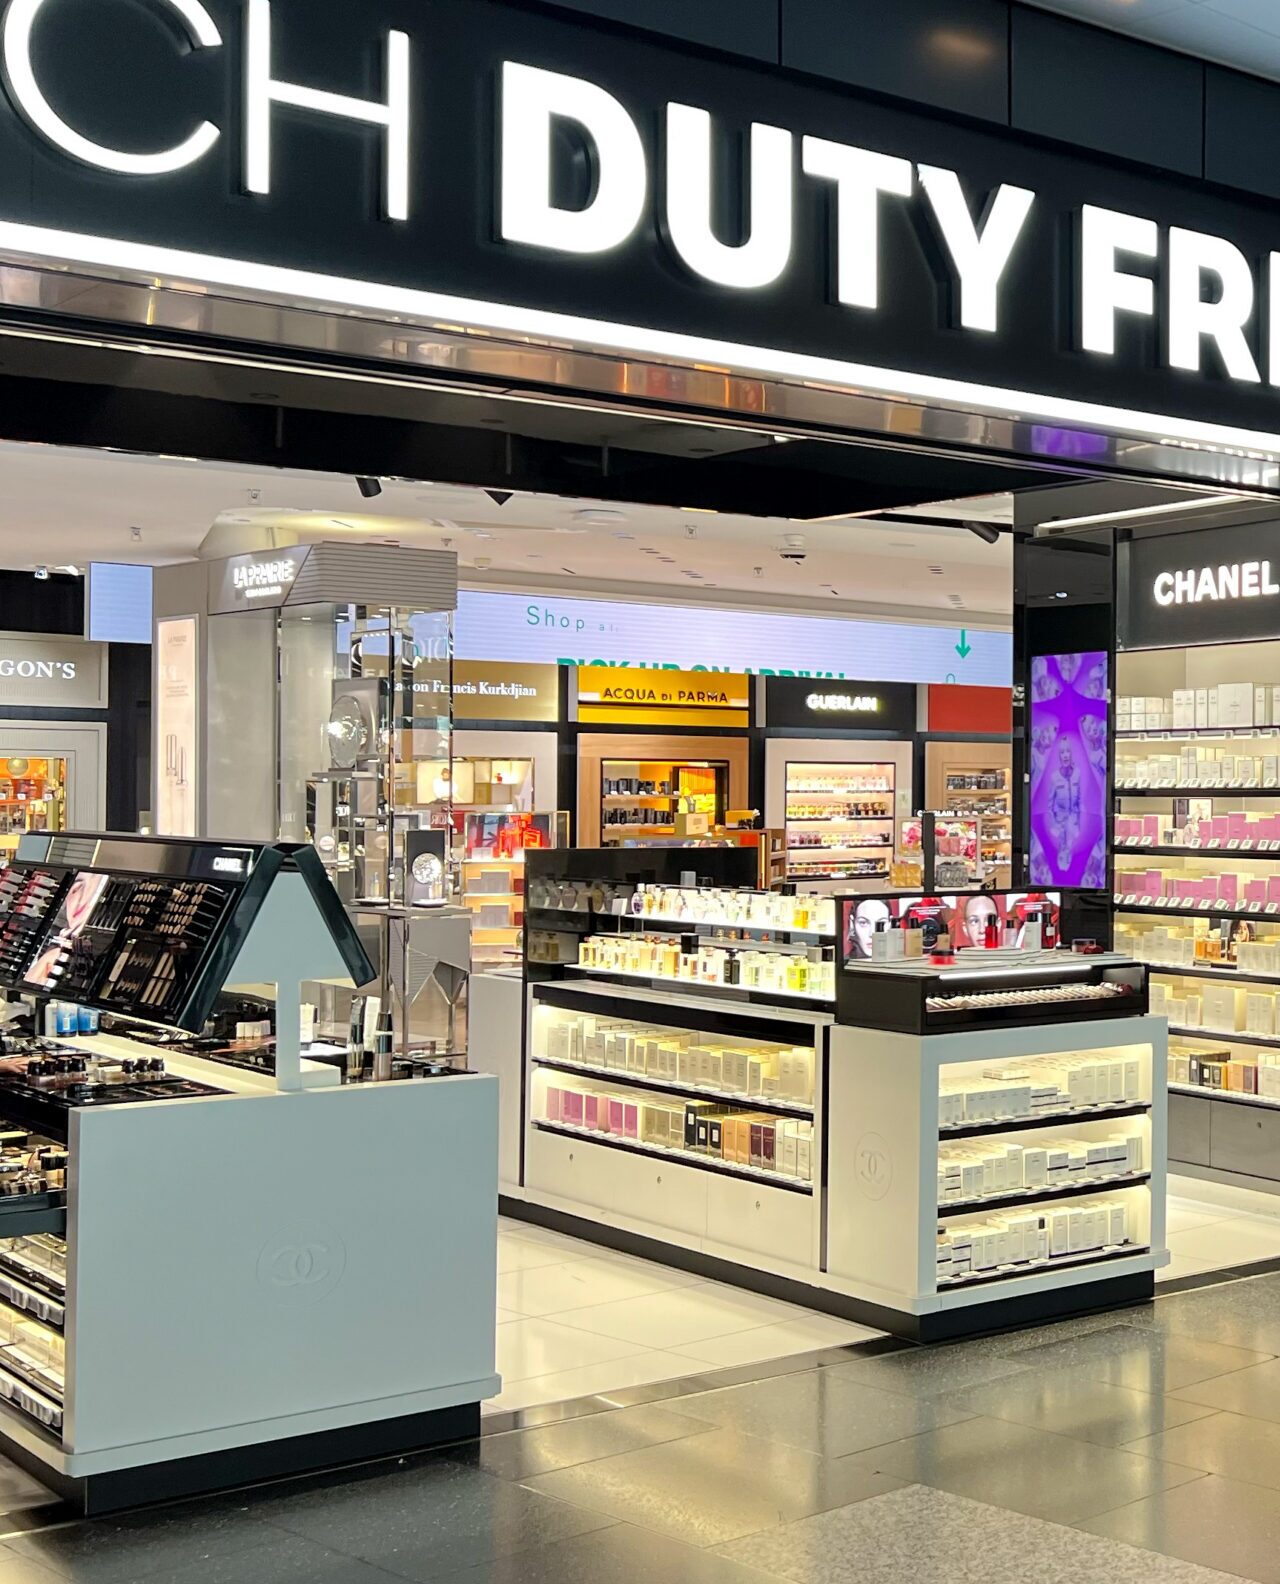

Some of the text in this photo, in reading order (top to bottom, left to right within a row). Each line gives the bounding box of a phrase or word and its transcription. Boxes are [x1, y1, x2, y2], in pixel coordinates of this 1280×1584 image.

[4, 0, 411, 221] CH
[502, 61, 1035, 333] DUTY
[1153, 560, 1280, 606] CHANEL
[526, 605, 585, 632] Shop
[0, 660, 76, 679] GON'S
[478, 681, 537, 699] Kurkdjian
[603, 687, 656, 701] ACQUA
[678, 690, 729, 703] PARMA
[806, 693, 877, 712] GUERLAIN
